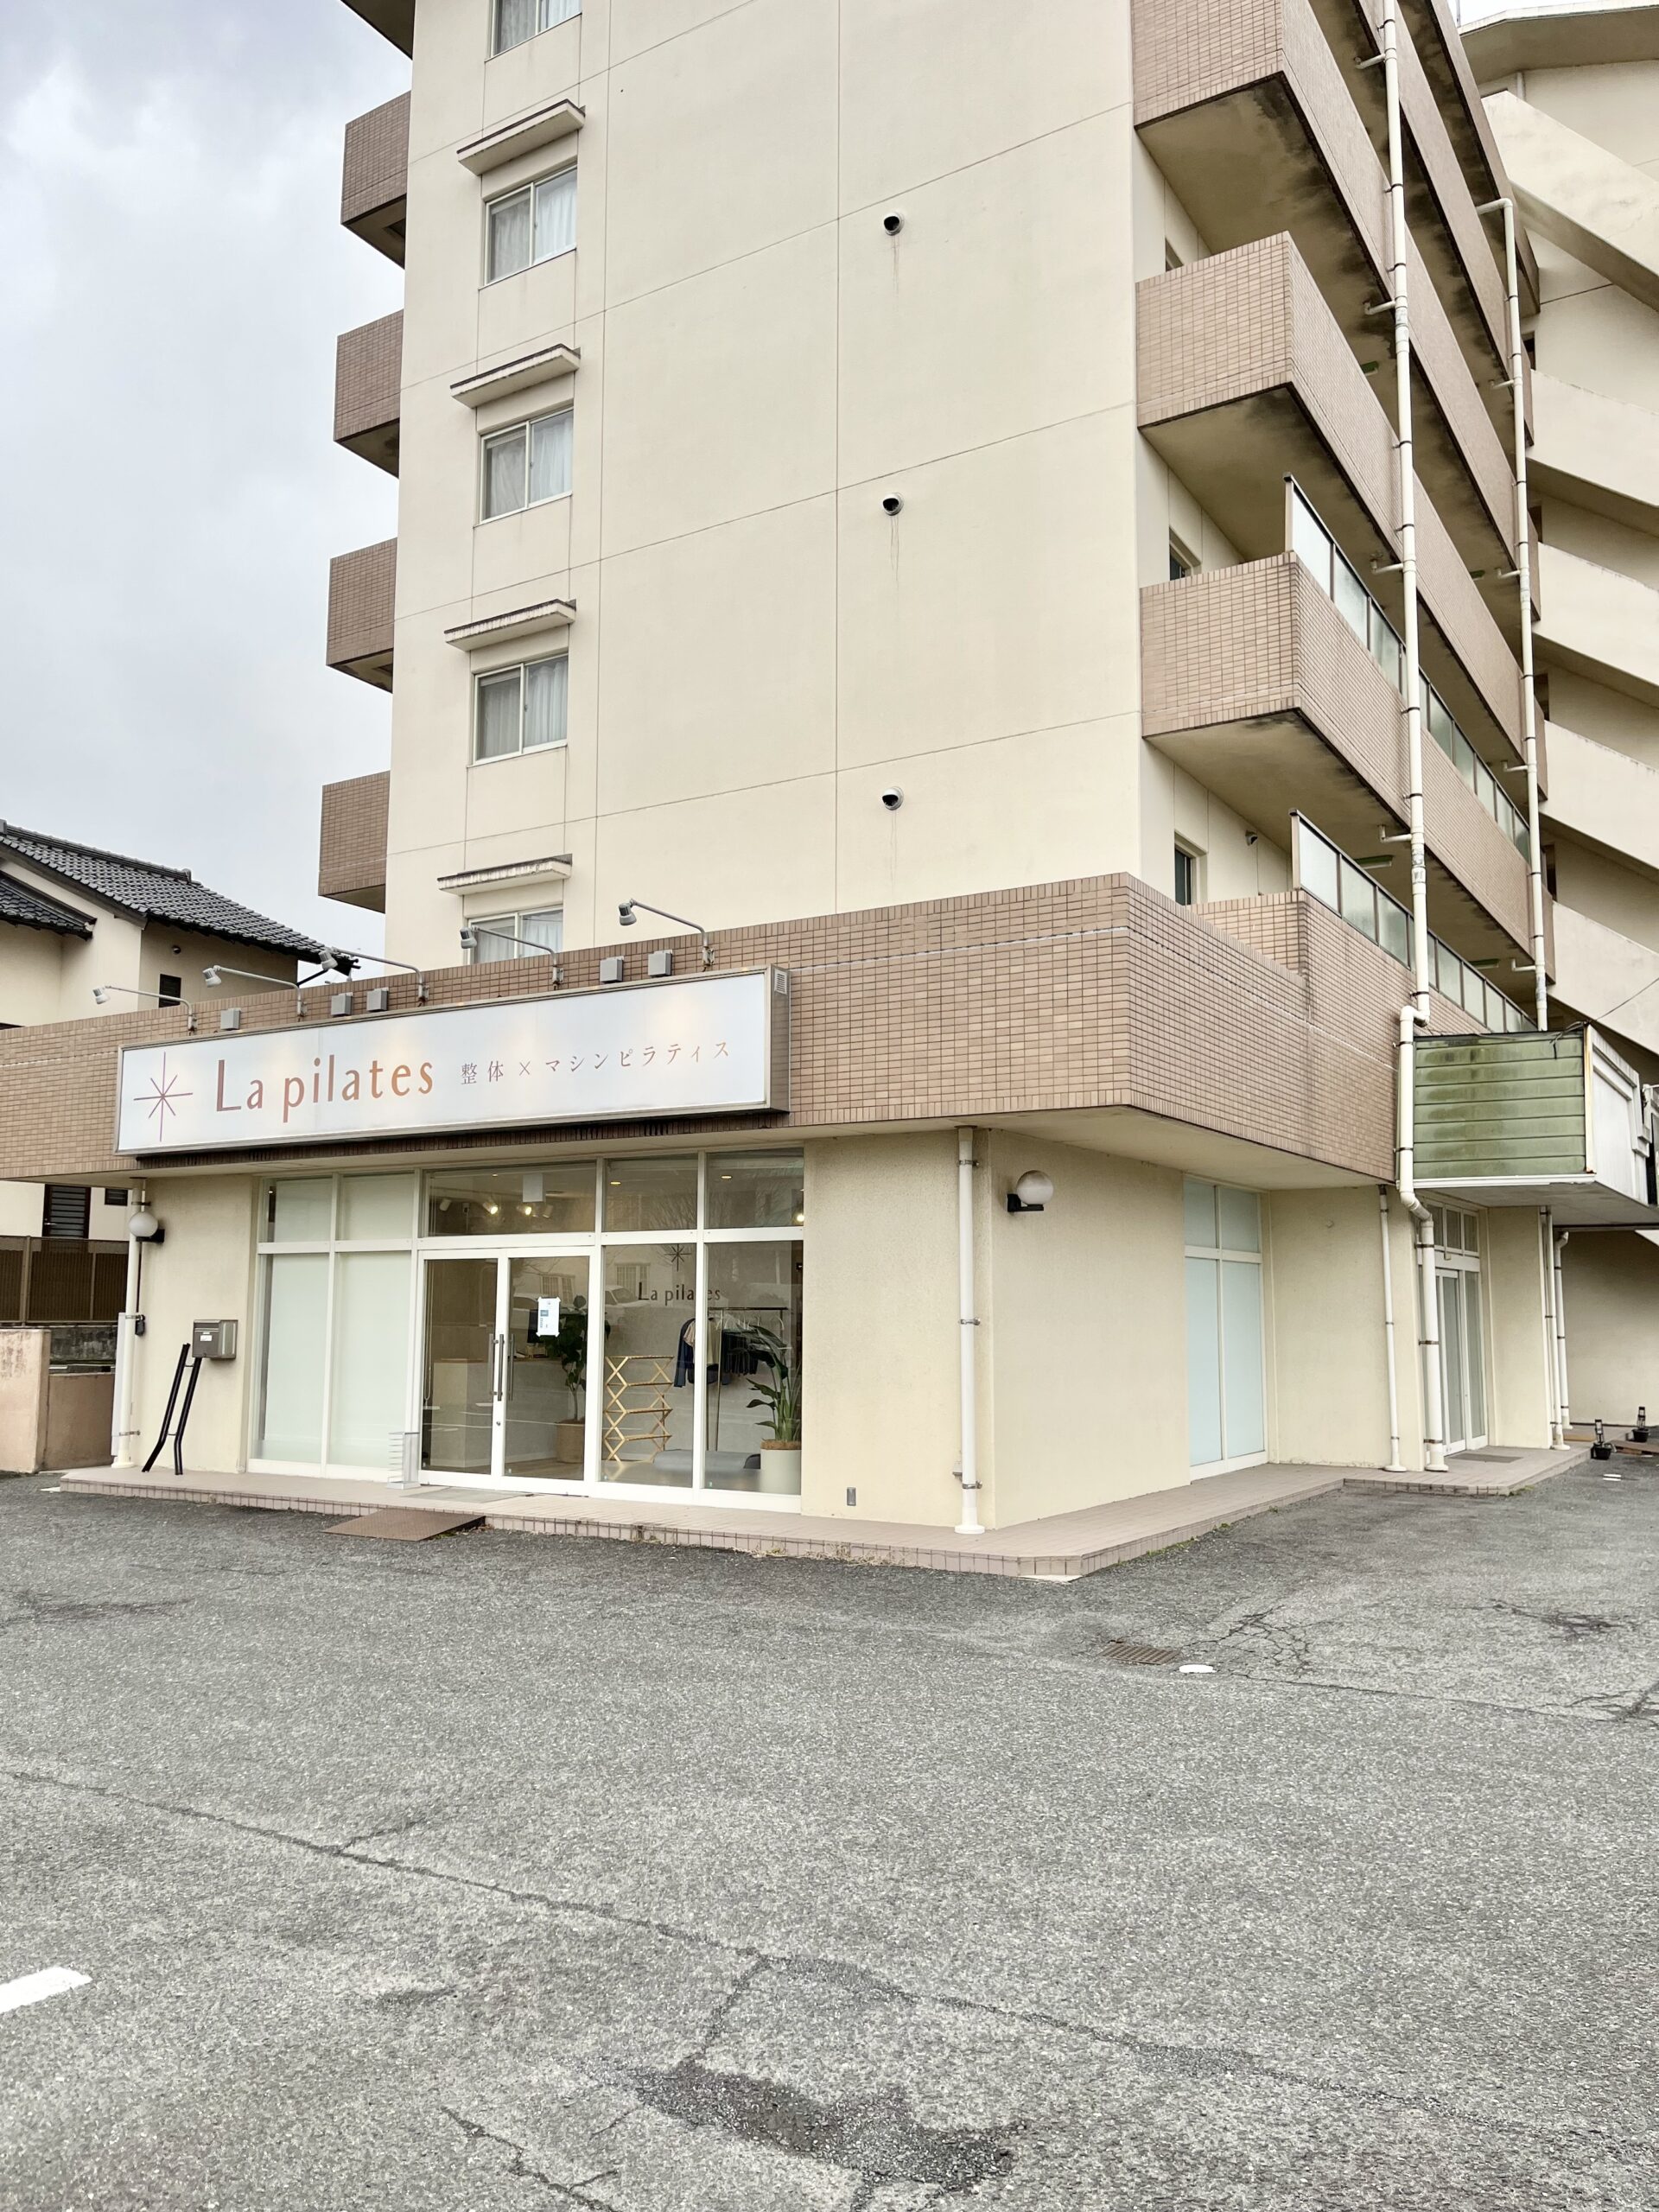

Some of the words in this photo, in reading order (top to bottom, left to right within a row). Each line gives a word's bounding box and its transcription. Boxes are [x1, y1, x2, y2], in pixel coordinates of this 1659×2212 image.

[216, 1059, 264, 1112] La
[283, 1054, 433, 1123] pilates
[638, 1281, 658, 1301] La
[664, 1283, 721, 1306] pilaes
